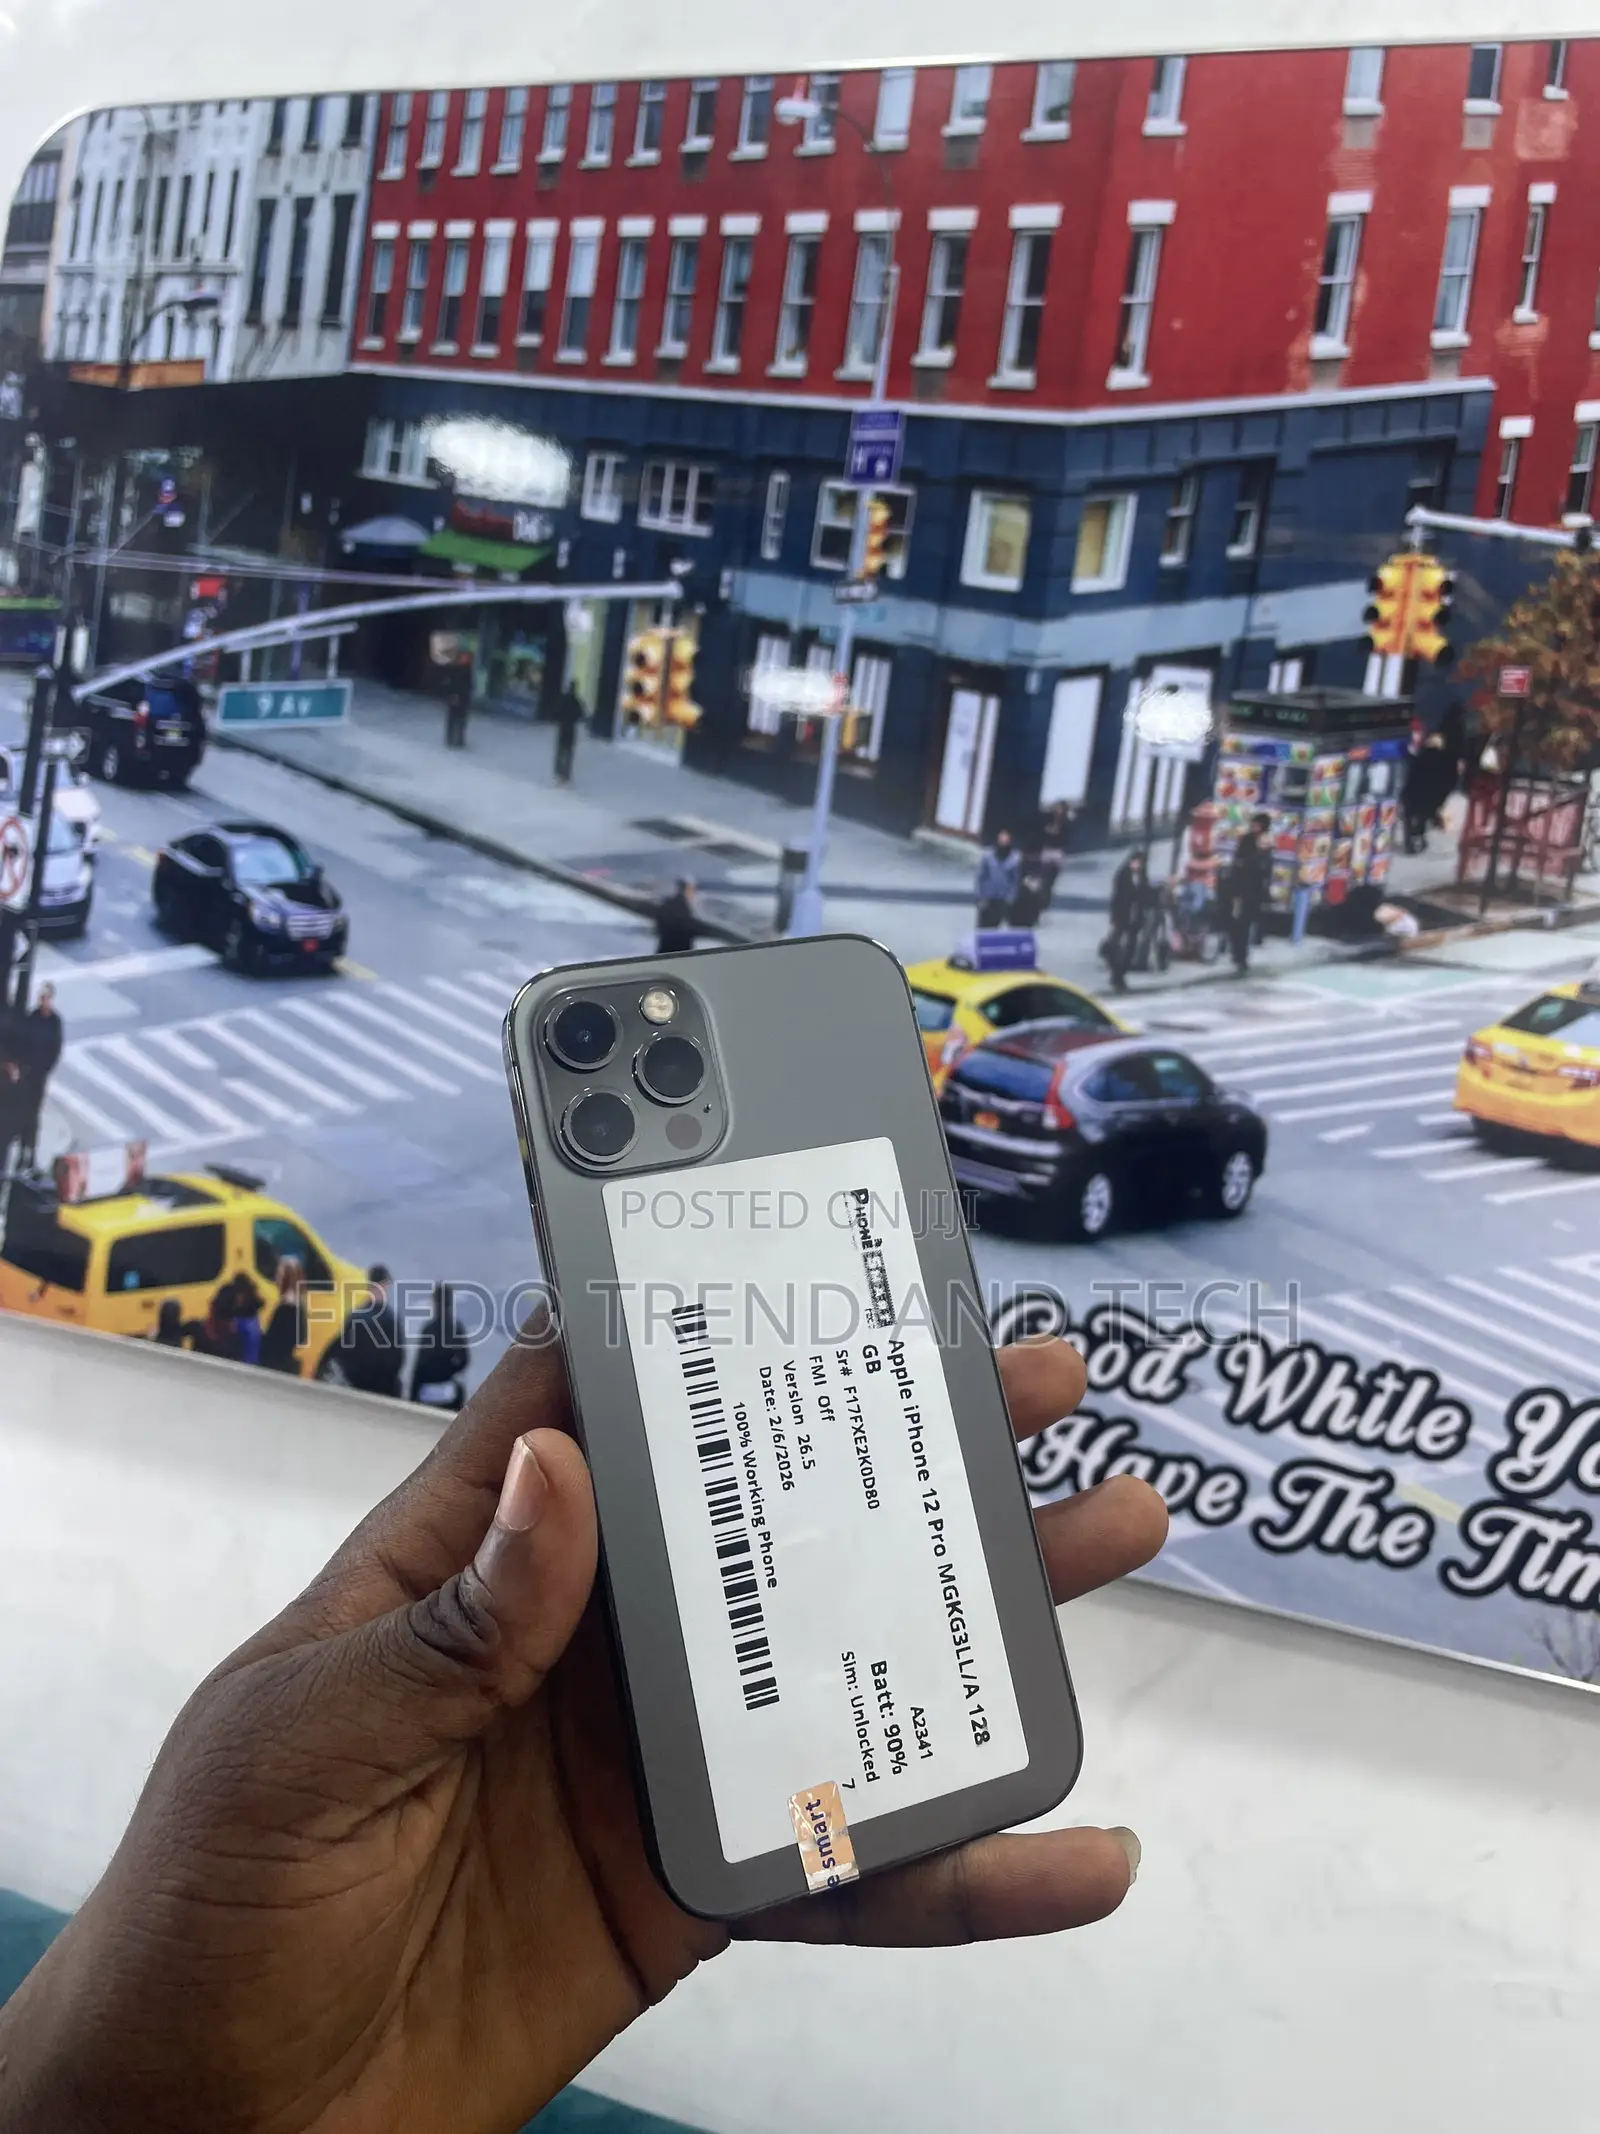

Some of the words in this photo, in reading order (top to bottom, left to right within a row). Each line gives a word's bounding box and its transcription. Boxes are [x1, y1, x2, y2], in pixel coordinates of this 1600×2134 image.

[809, 1355, 827, 1386] FMI
[818, 1395, 835, 1421] Off
[836, 1349, 853, 1377] Sr#
[862, 1344, 882, 1374] GB
[887, 1339, 914, 1399] Apple
[759, 1366, 776, 1412] Date:
[769, 1415, 795, 1491] 2/6/2026
[783, 1360, 804, 1425] Version
[797, 1434, 816, 1469] 26.5
[1221, 1334, 1468, 1458] While
[903, 1405, 930, 1481] iPhone
[733, 1401, 752, 1448] 100%
[743, 1450, 766, 1528] Working
[758, 1531, 777, 1588] Phone
[922, 1488, 940, 1513] 12
[1255, 1461, 1431, 1566] The
[928, 1518, 946, 1557] Pro
[937, 1563, 980, 1699] MGKG3LL/A
[841, 1651, 858, 1690] Sim:
[850, 1695, 880, 1783] Unlocked
[871, 1660, 894, 1718] Batt:
[884, 1724, 908, 1775] 90%
[910, 1706, 933, 1760] A2341
[969, 1704, 990, 1746] 128
[842, 1778, 855, 1789] 7
[805, 1799, 836, 1869] smart
